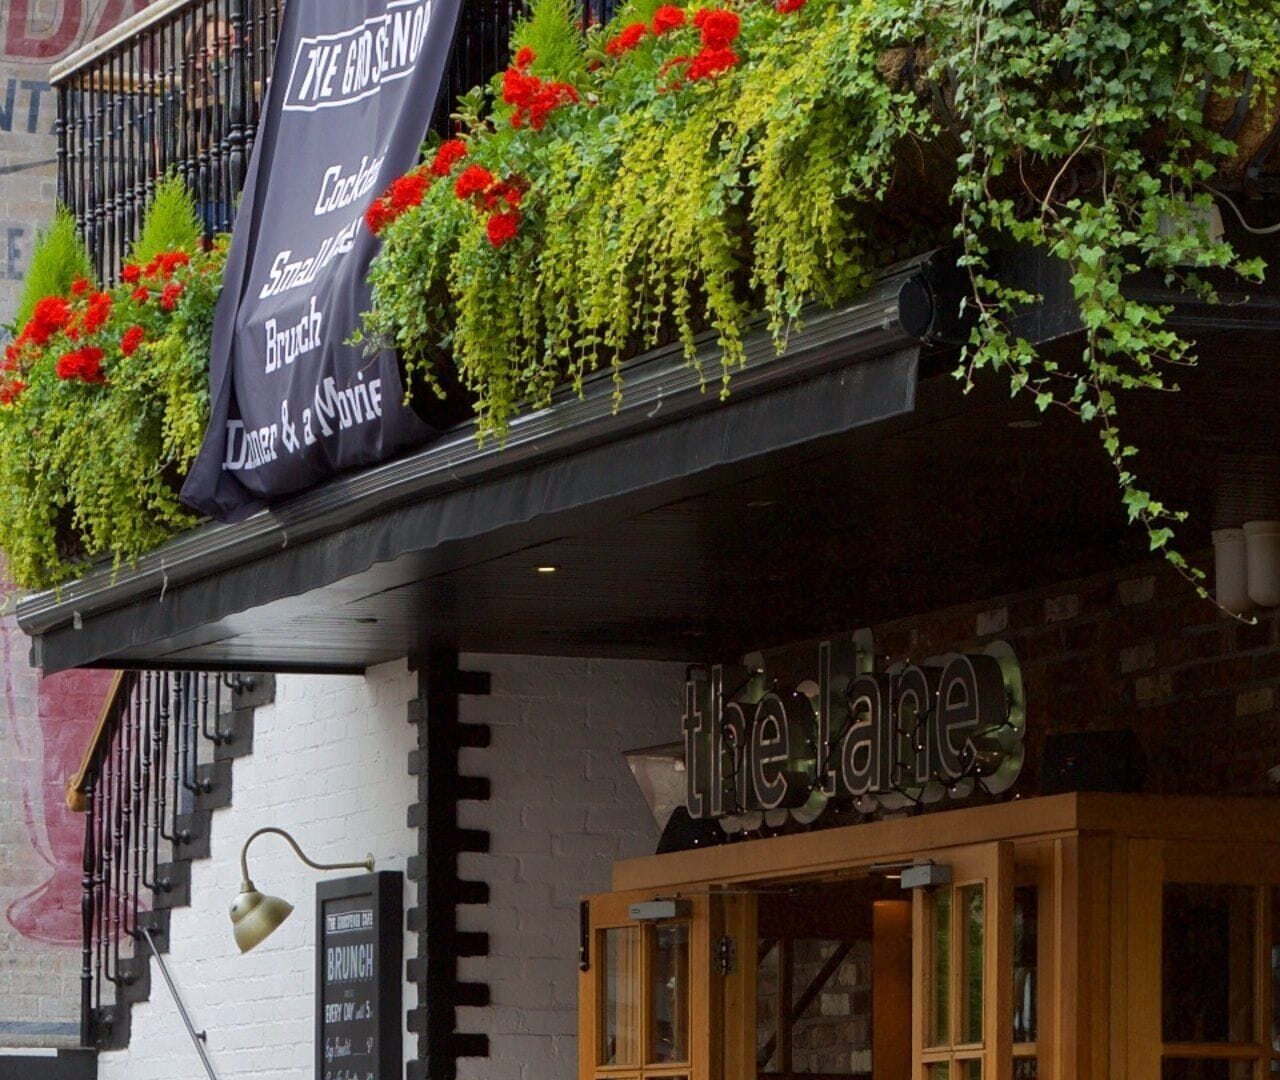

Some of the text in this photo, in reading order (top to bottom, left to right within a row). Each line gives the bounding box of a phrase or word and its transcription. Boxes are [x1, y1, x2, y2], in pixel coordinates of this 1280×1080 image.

[259, 236, 335, 299] Small
[281, 399, 301, 453] &
[302, 407, 317, 446] a
[682, 640, 982, 820] the lane
[328, 944, 373, 982] BRUNCH
